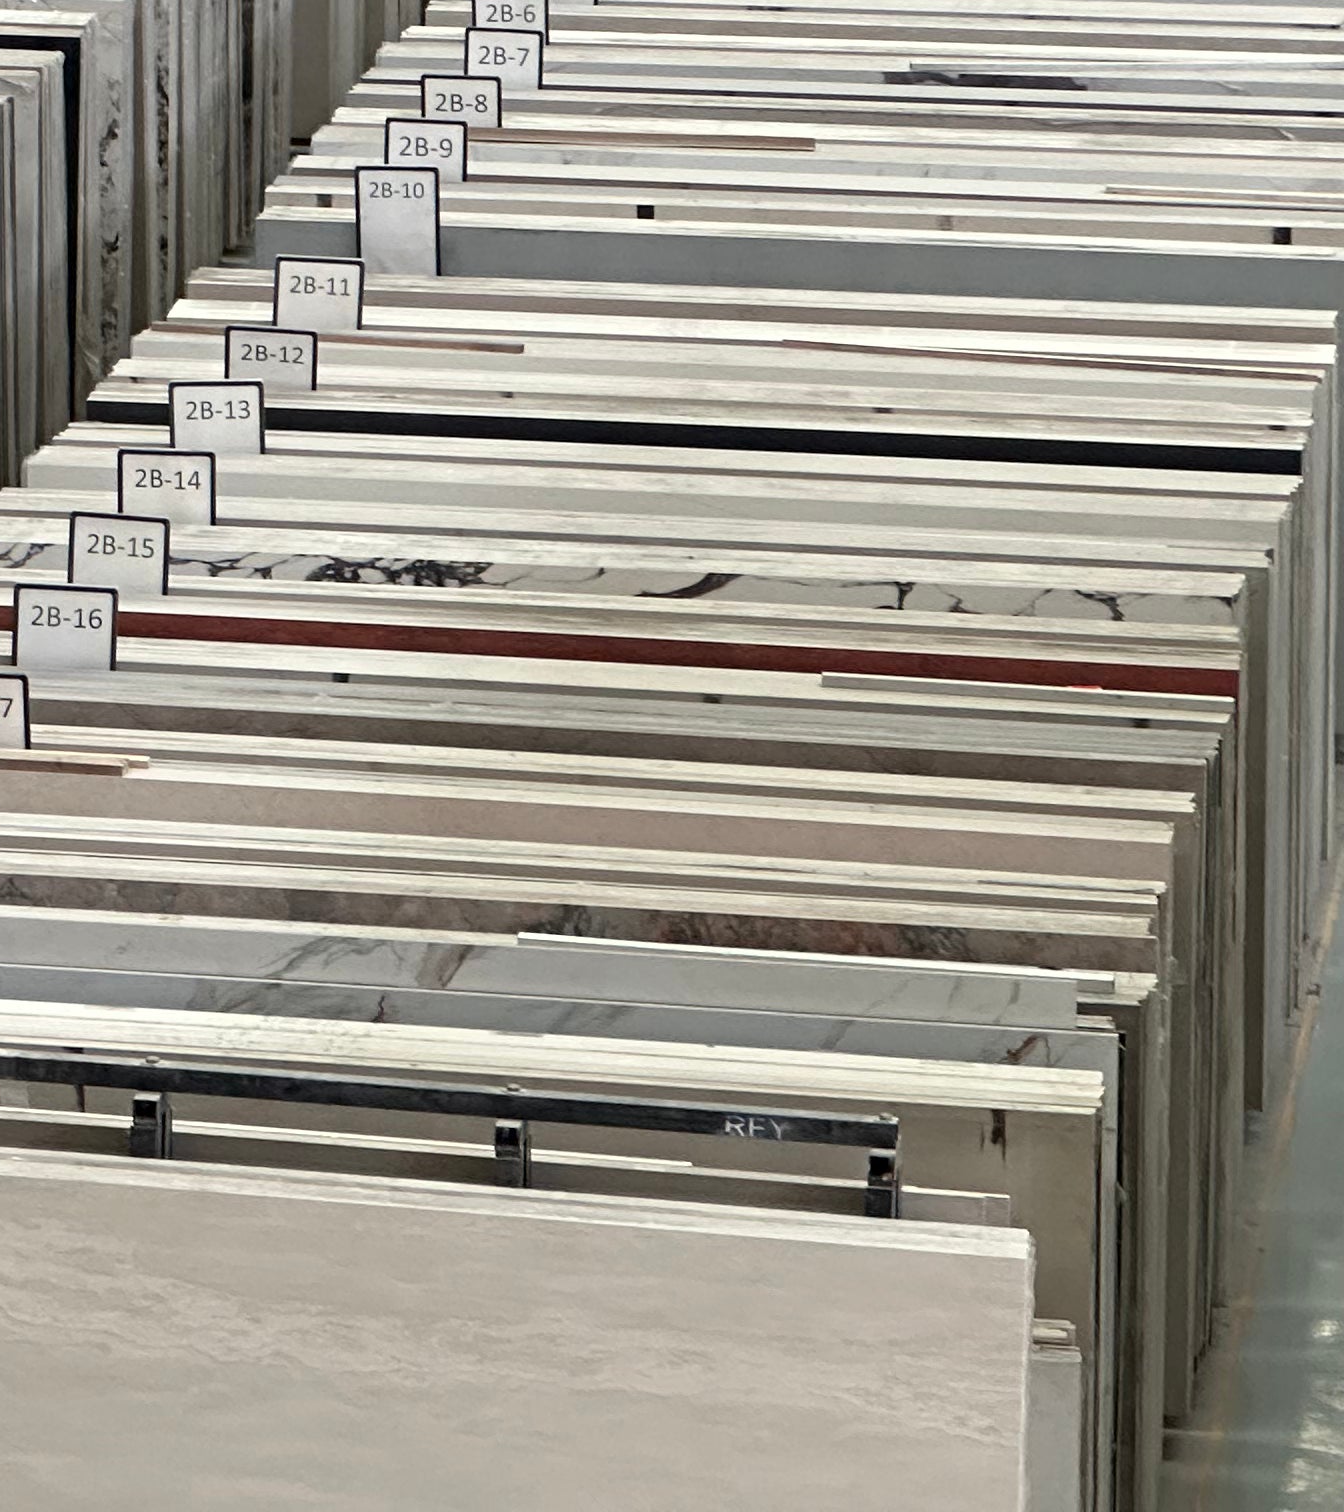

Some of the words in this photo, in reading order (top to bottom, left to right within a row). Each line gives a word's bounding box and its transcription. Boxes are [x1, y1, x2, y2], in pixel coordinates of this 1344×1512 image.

[486, 4, 535, 23] 2B-6
[479, 46, 529, 66] 2B-7
[436, 94, 487, 113] 2B-8
[400, 136, 452, 158] 2B-9
[370, 182, 424, 198] 2B-10
[290, 276, 350, 296] 2B-11
[241, 344, 304, 364] 2B-12
[186, 400, 250, 420] 2B-13
[136, 469, 200, 490] 2B-14
[88, 534, 154, 558] 2B-15
[32, 606, 102, 629] 2B-16
